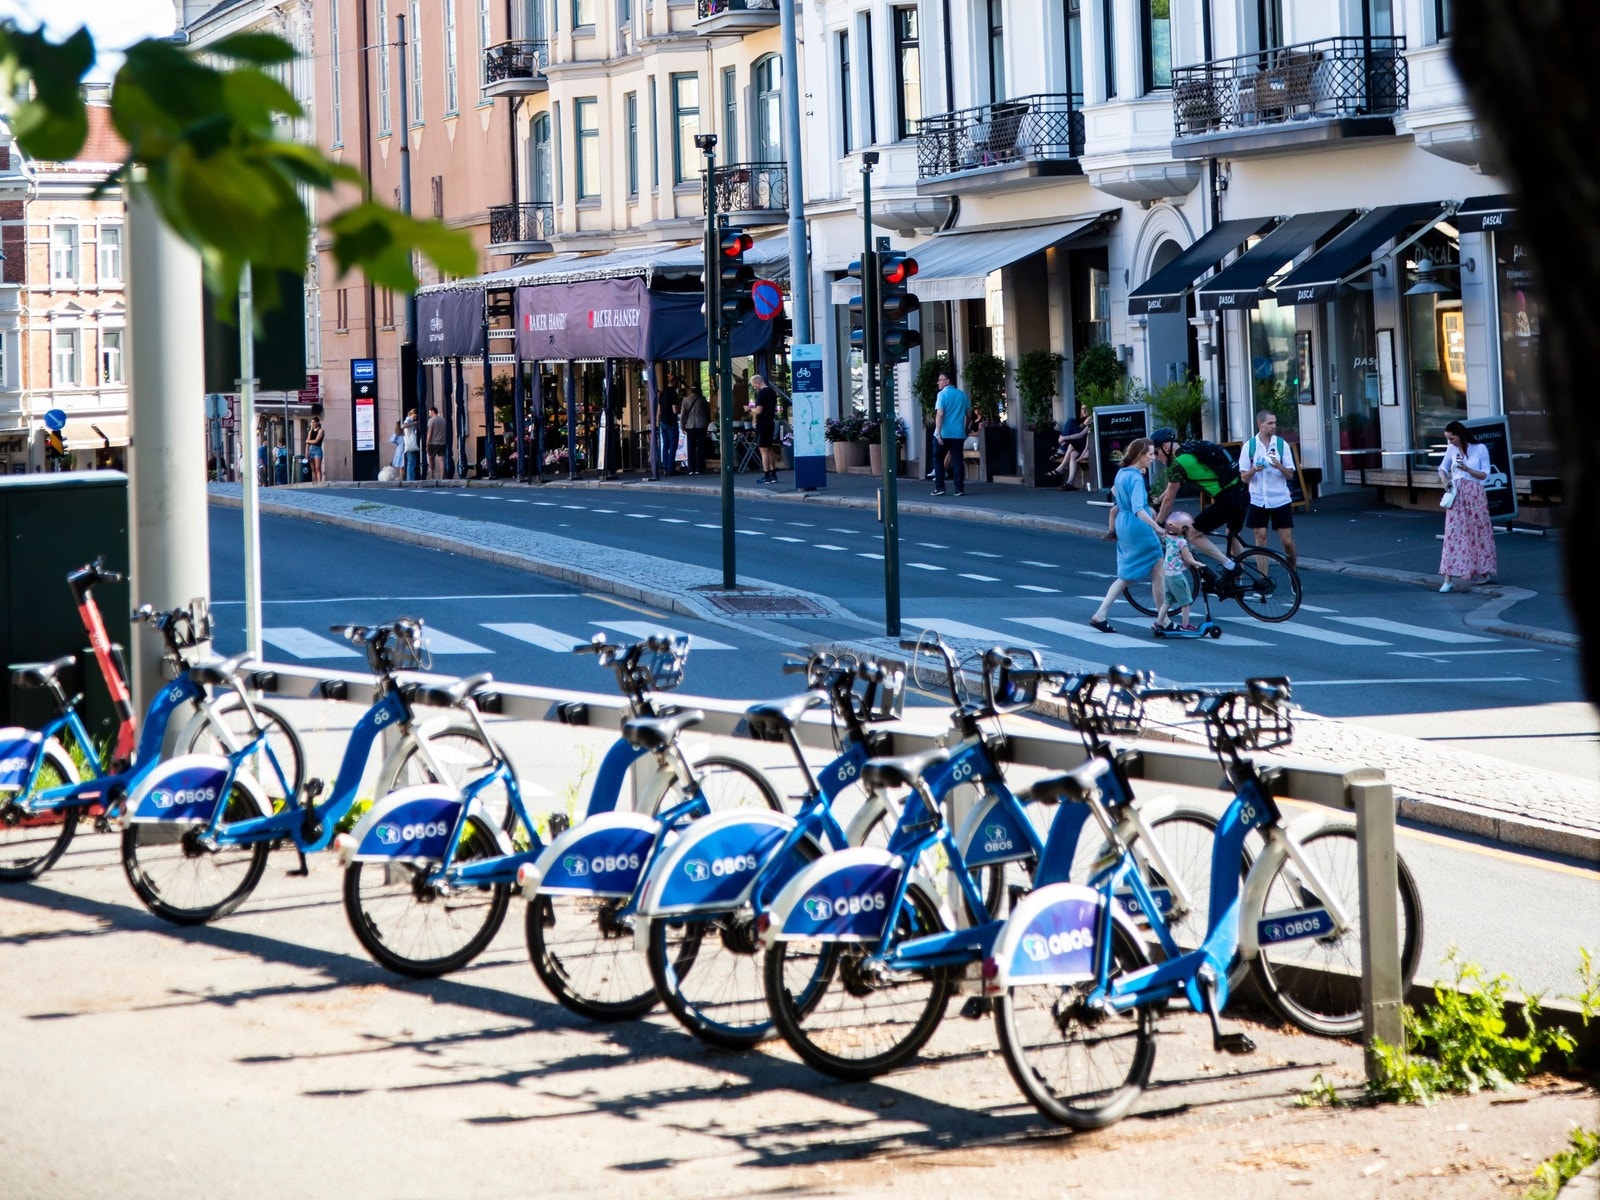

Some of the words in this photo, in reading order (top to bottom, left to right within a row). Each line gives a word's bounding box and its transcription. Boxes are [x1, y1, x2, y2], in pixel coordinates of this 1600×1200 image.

[593, 310, 612, 328] BAKER
[0, 757, 28, 773] BOS
[174, 787, 215, 805] OBOS
[402, 821, 447, 841] OBOS
[984, 840, 1013, 852] OBOS
[591, 853, 639, 874] OBOS
[711, 854, 757, 877] OBOS
[834, 892, 886, 916] OBOS
[1285, 916, 1320, 936] OBOS
[1048, 926, 1094, 956] OBOS
